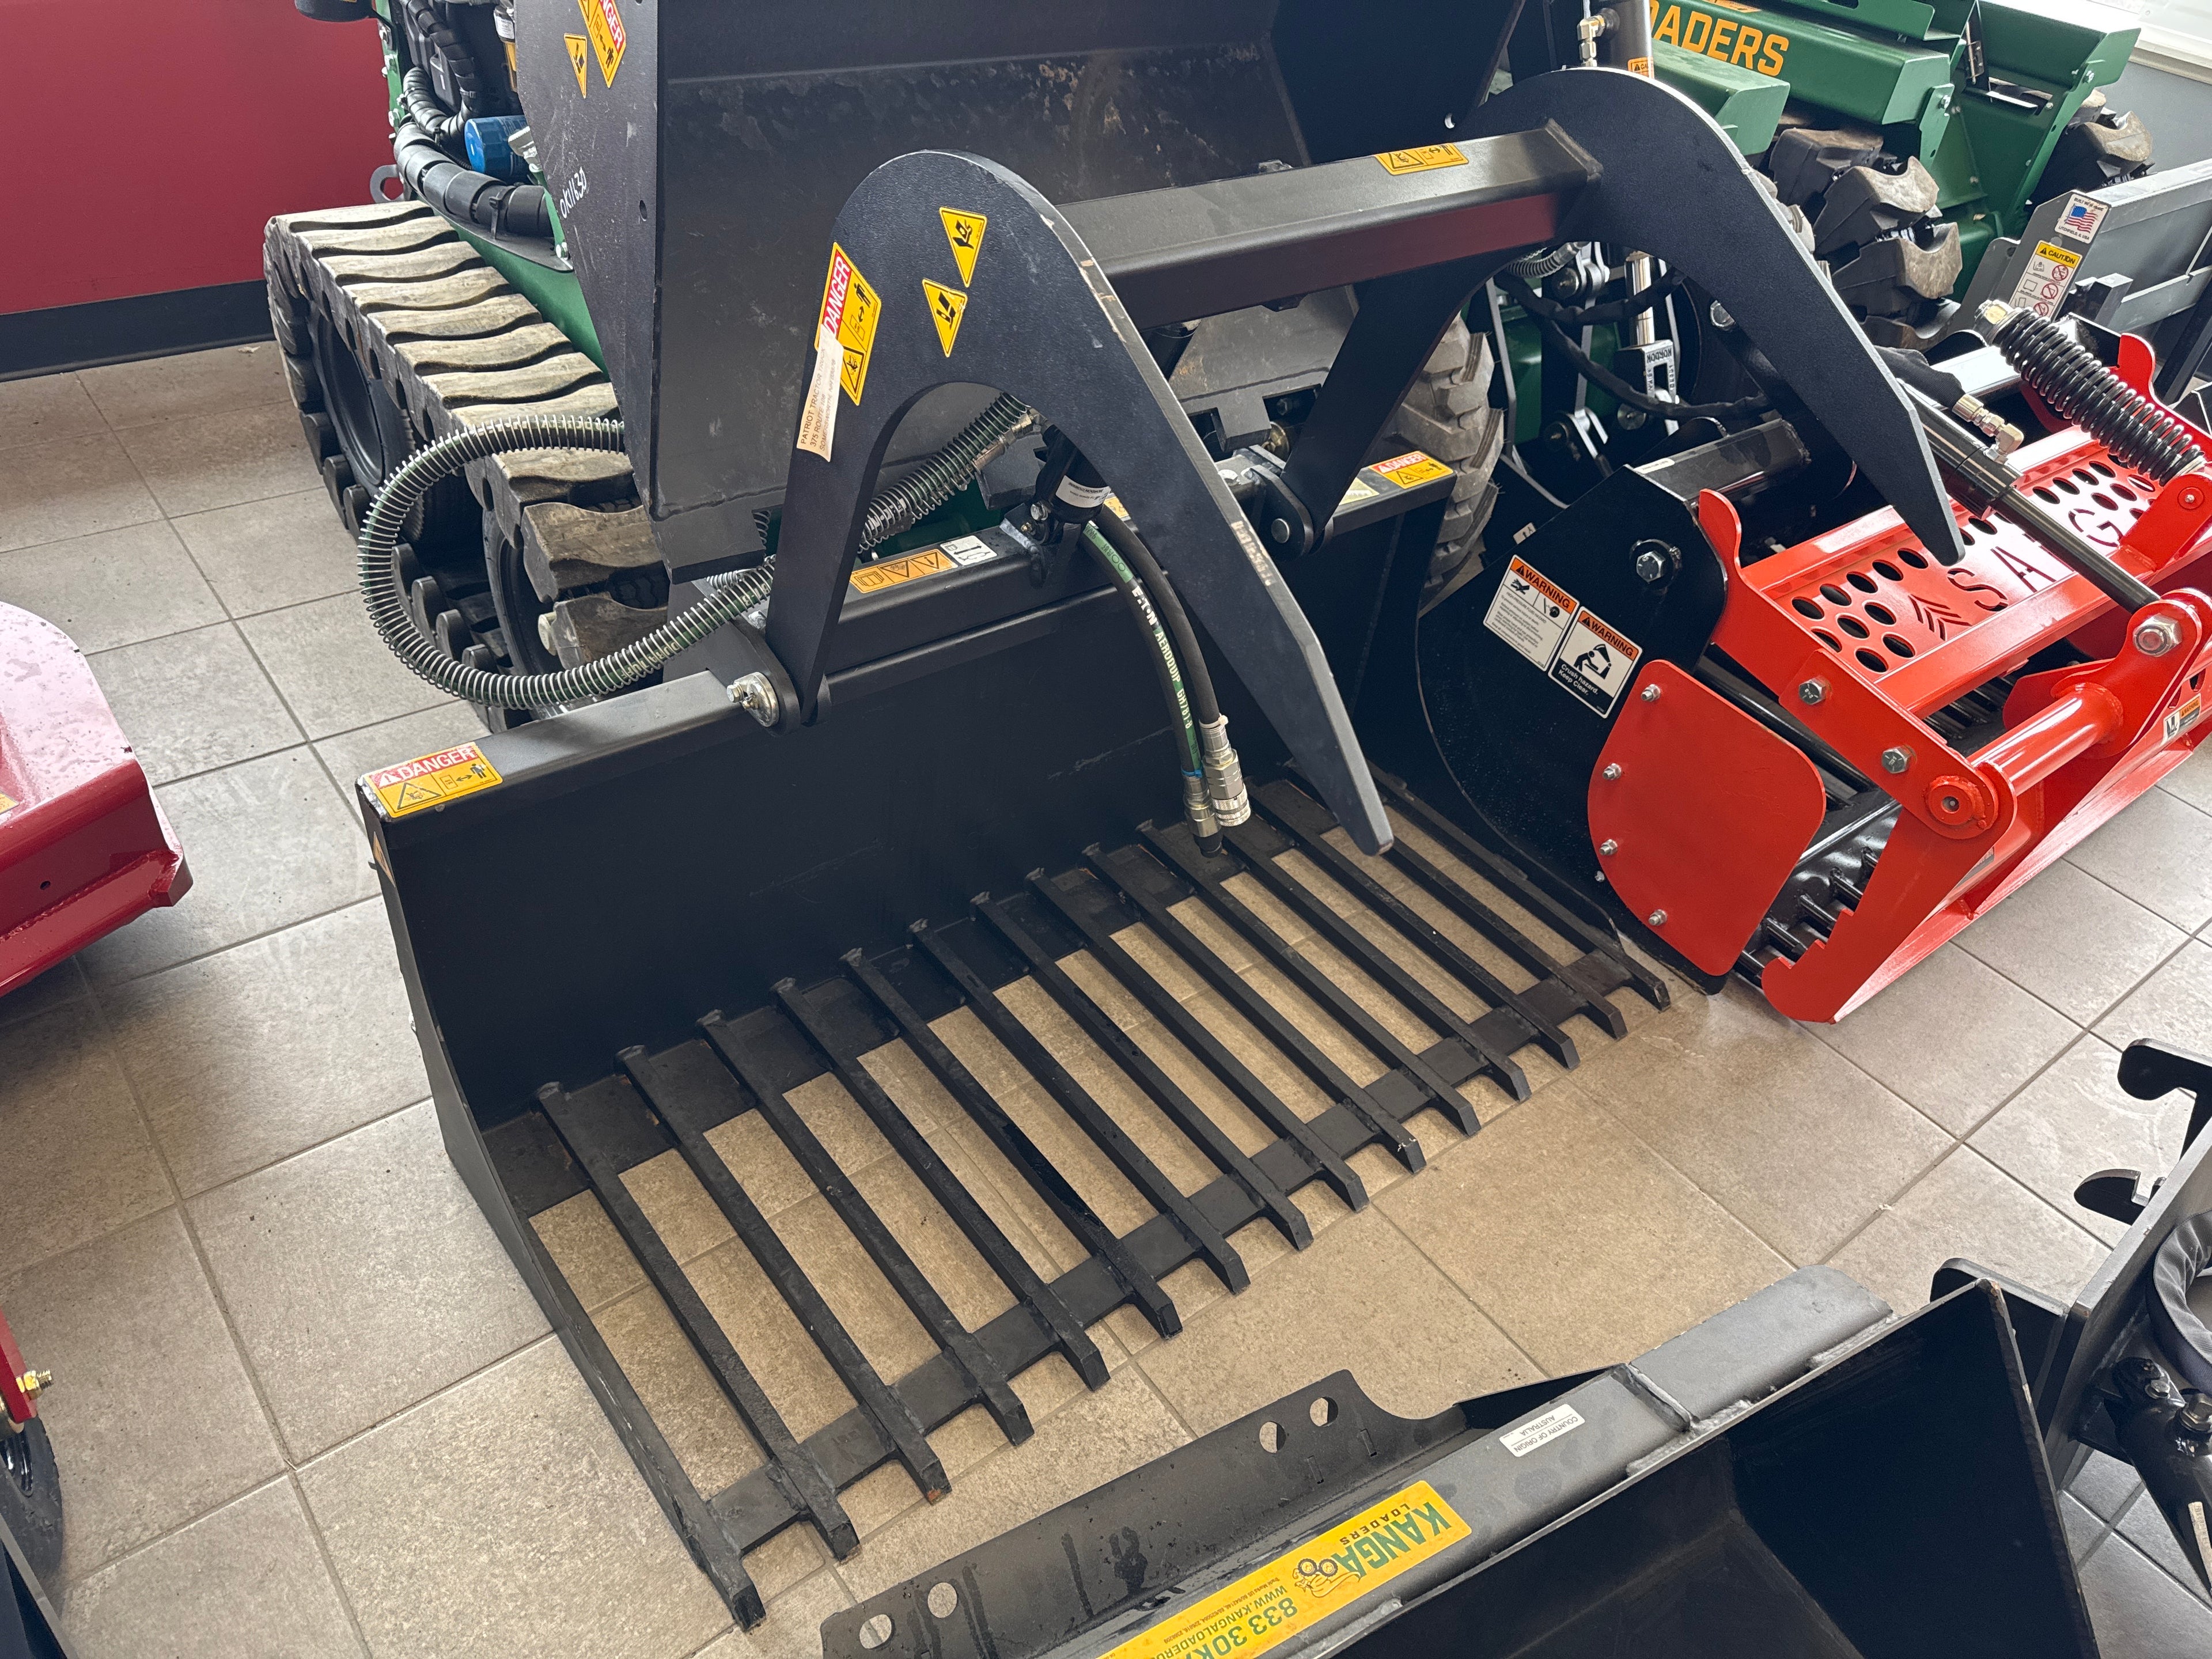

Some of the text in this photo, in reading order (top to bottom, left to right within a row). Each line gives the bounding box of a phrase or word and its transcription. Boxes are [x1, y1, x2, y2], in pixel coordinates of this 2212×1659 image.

[800, 410, 815, 444] PATRIOT
[809, 373, 824, 408] TRACTOR
[813, 407, 825, 433] ROUTE
[809, 433, 819, 446] 375
[1525, 570, 1571, 608] WARNING
[1155, 631, 1181, 683] AEROQUIP
[1592, 621, 1634, 657] WARNING
[1557, 669, 1574, 684] Keep
[1560, 663, 1600, 695] Crush hazard.
[397, 747, 476, 780] DANGER
[1513, 1416, 1578, 1452] COUNTRY OF ORIGIN
[1519, 1415, 1554, 1436] AUSTRALIA
[1330, 1501, 1451, 1578] KANGA
[1339, 1503, 1410, 1545] LOADERS
[1152, 1585, 1287, 1659] WWW.KANGALOADERU
[1185, 1596, 1298, 1659] 833 30K
